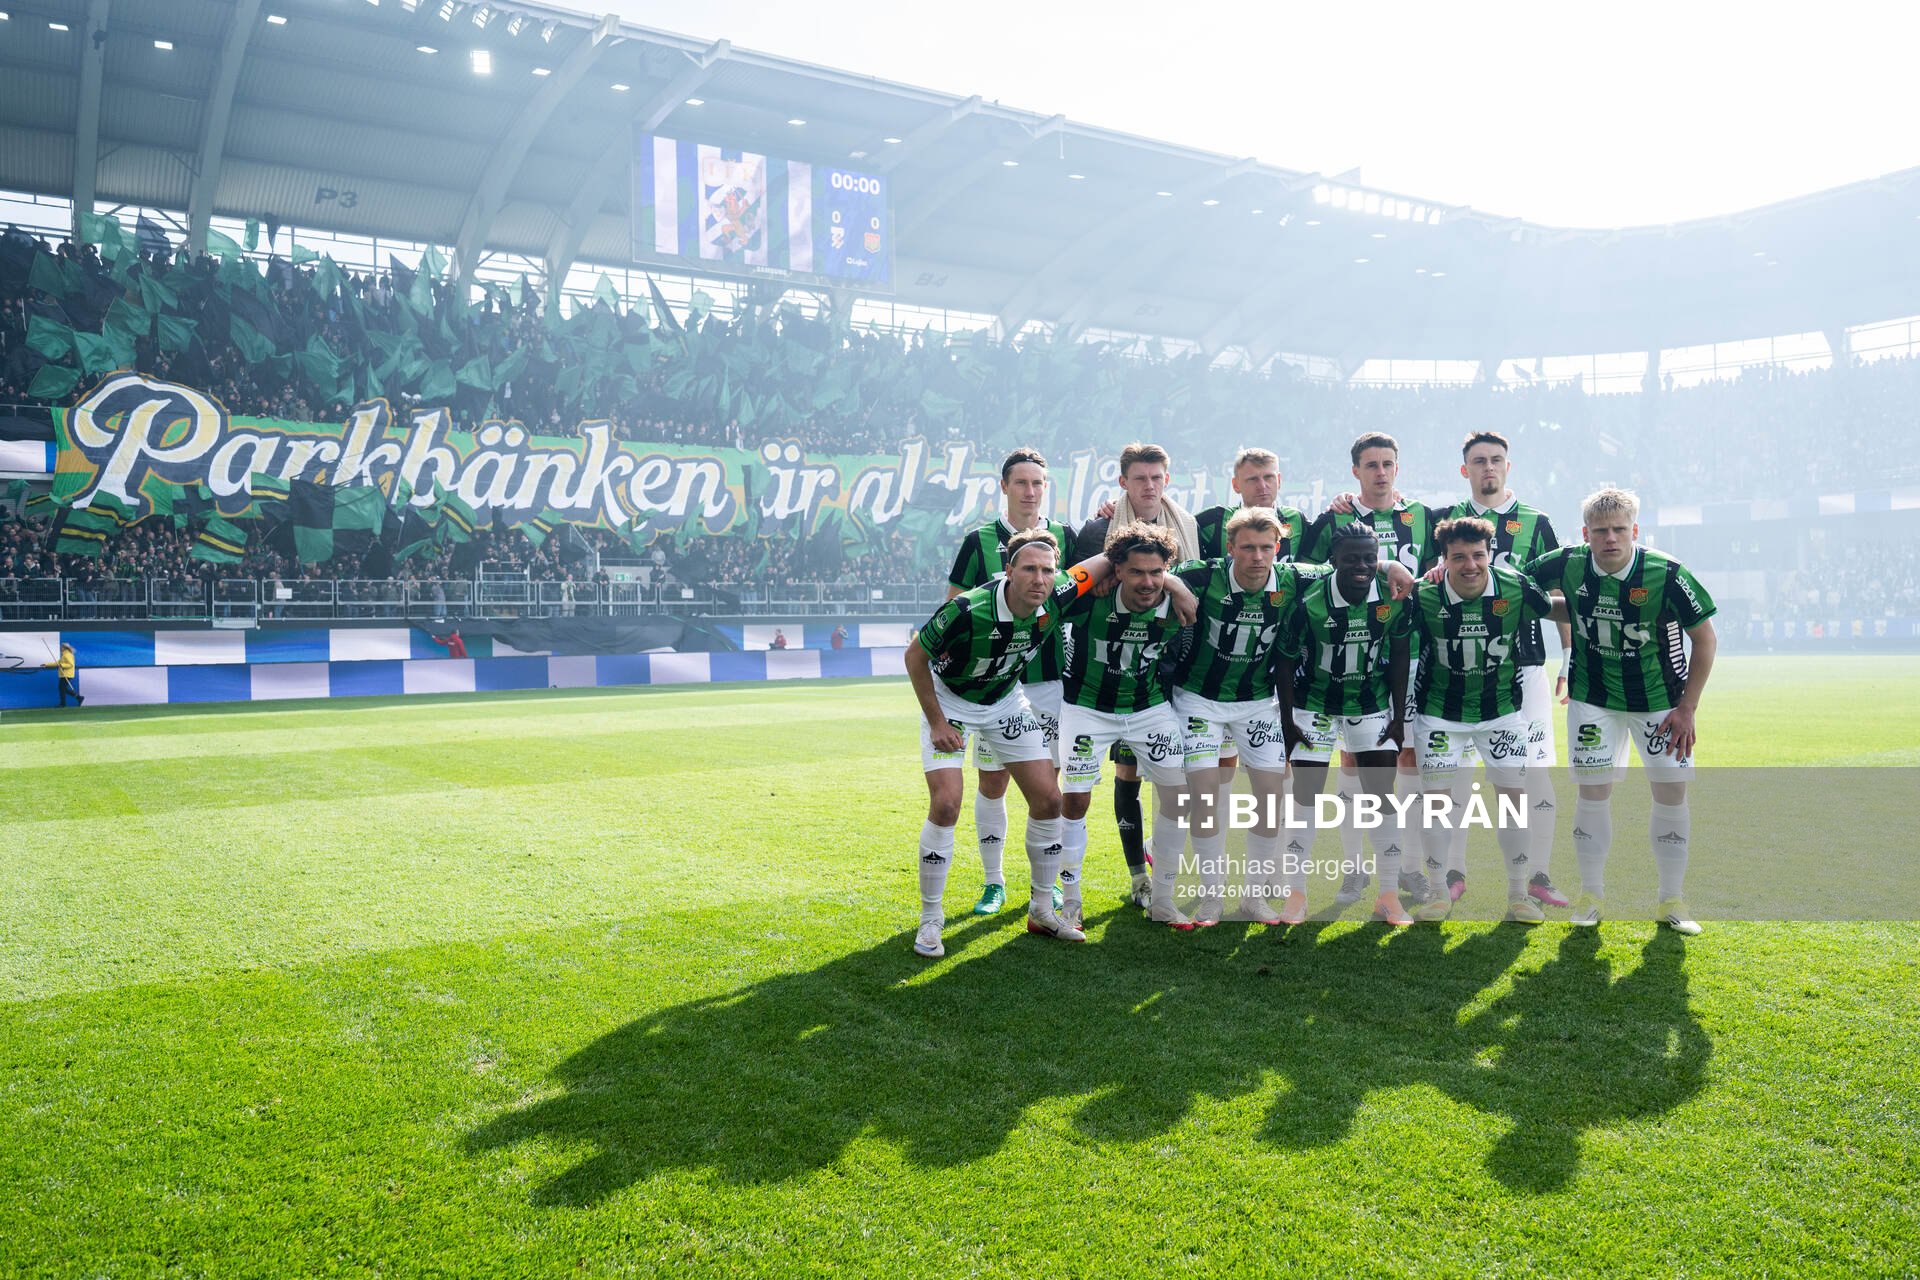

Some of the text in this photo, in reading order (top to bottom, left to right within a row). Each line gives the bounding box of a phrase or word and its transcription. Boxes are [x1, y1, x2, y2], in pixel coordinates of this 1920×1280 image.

[831, 172, 880, 194] 00:00
[315, 188, 358, 208] P3
[832, 211, 841, 223] 0
[870, 217, 879, 229] 0
[71, 374, 728, 530] Parkbänken
[760, 443, 836, 521] är
[851, 440, 1052, 527] aldr
[1675, 575, 1703, 614] stadium
[1595, 607, 1621, 616] SKAB
[1575, 612, 1651, 650] ITS
[1434, 632, 1512, 671] ITS
